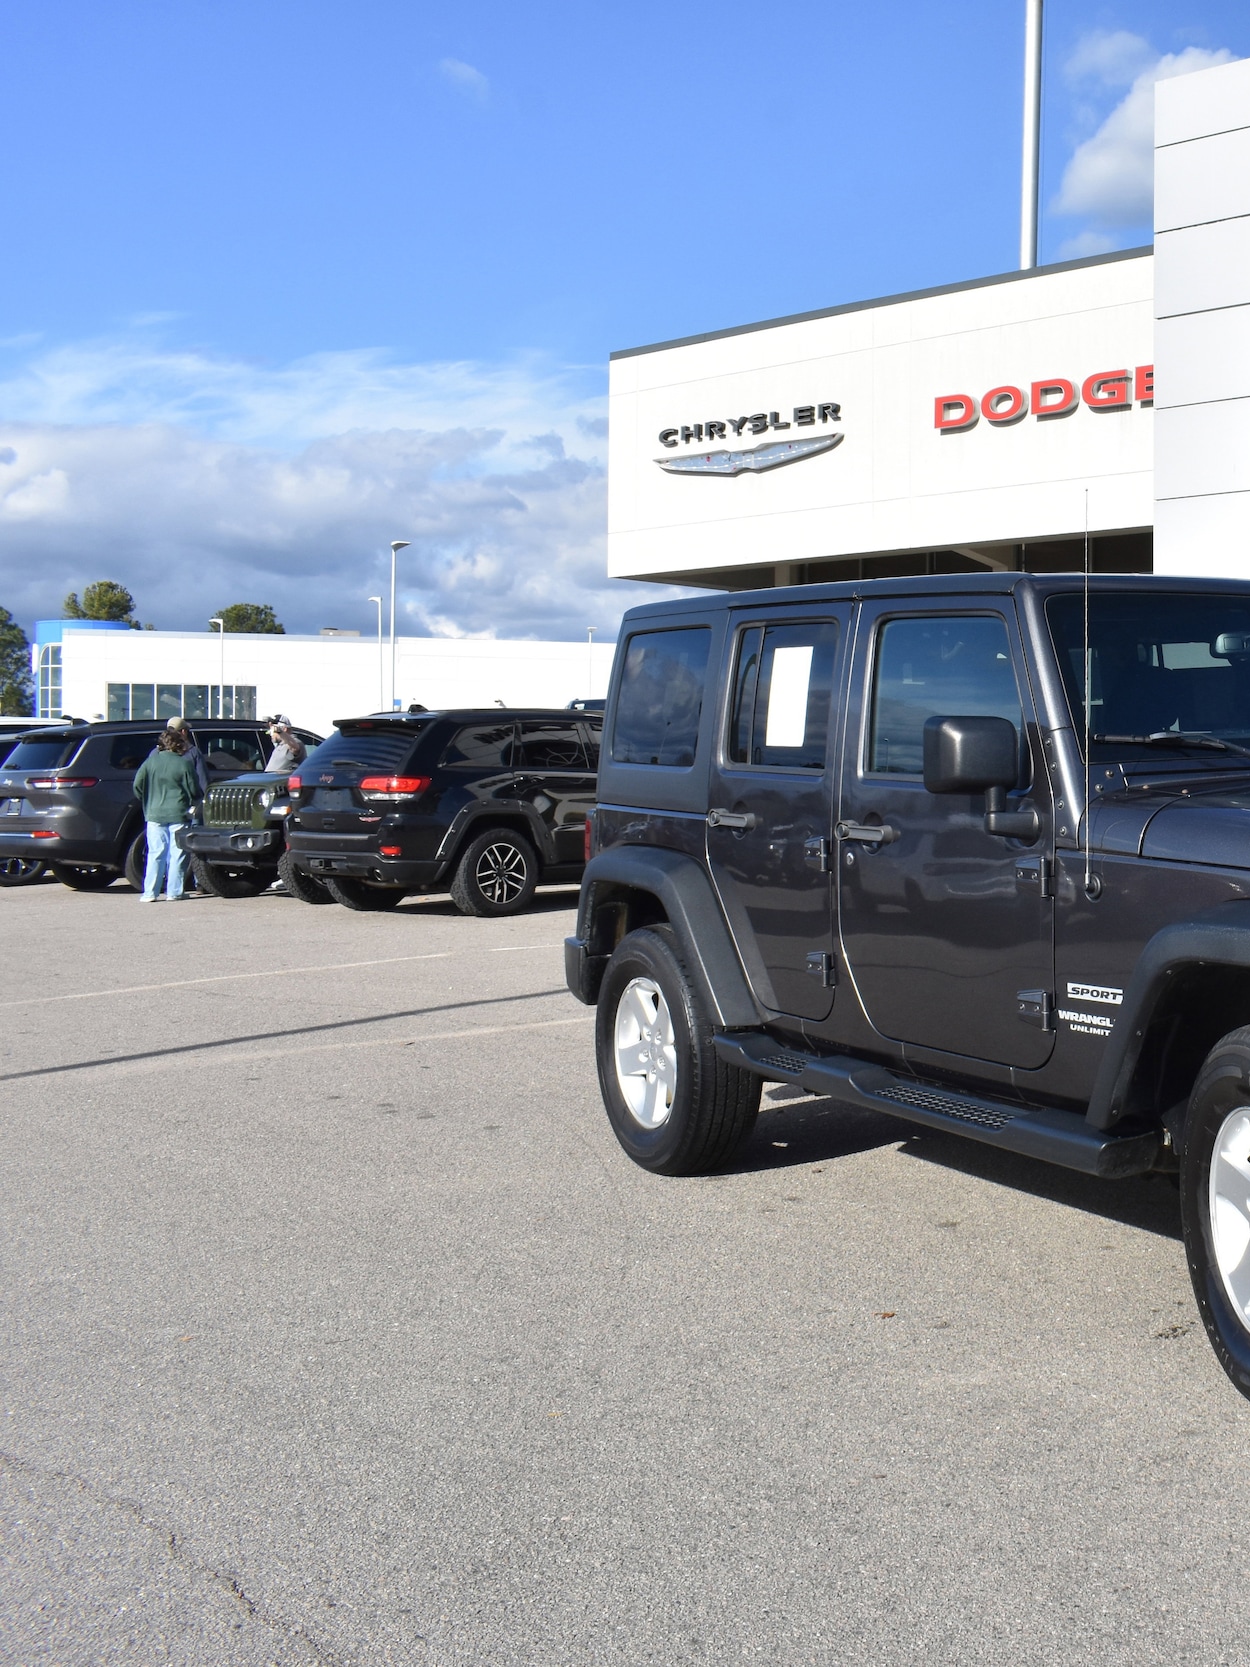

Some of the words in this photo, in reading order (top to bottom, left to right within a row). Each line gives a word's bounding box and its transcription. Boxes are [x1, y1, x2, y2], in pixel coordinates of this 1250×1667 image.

[658, 401, 842, 447] CHRYSLER
[1069, 985, 1123, 1002] SPORT
[1057, 1009, 1116, 1028] WRANGL
